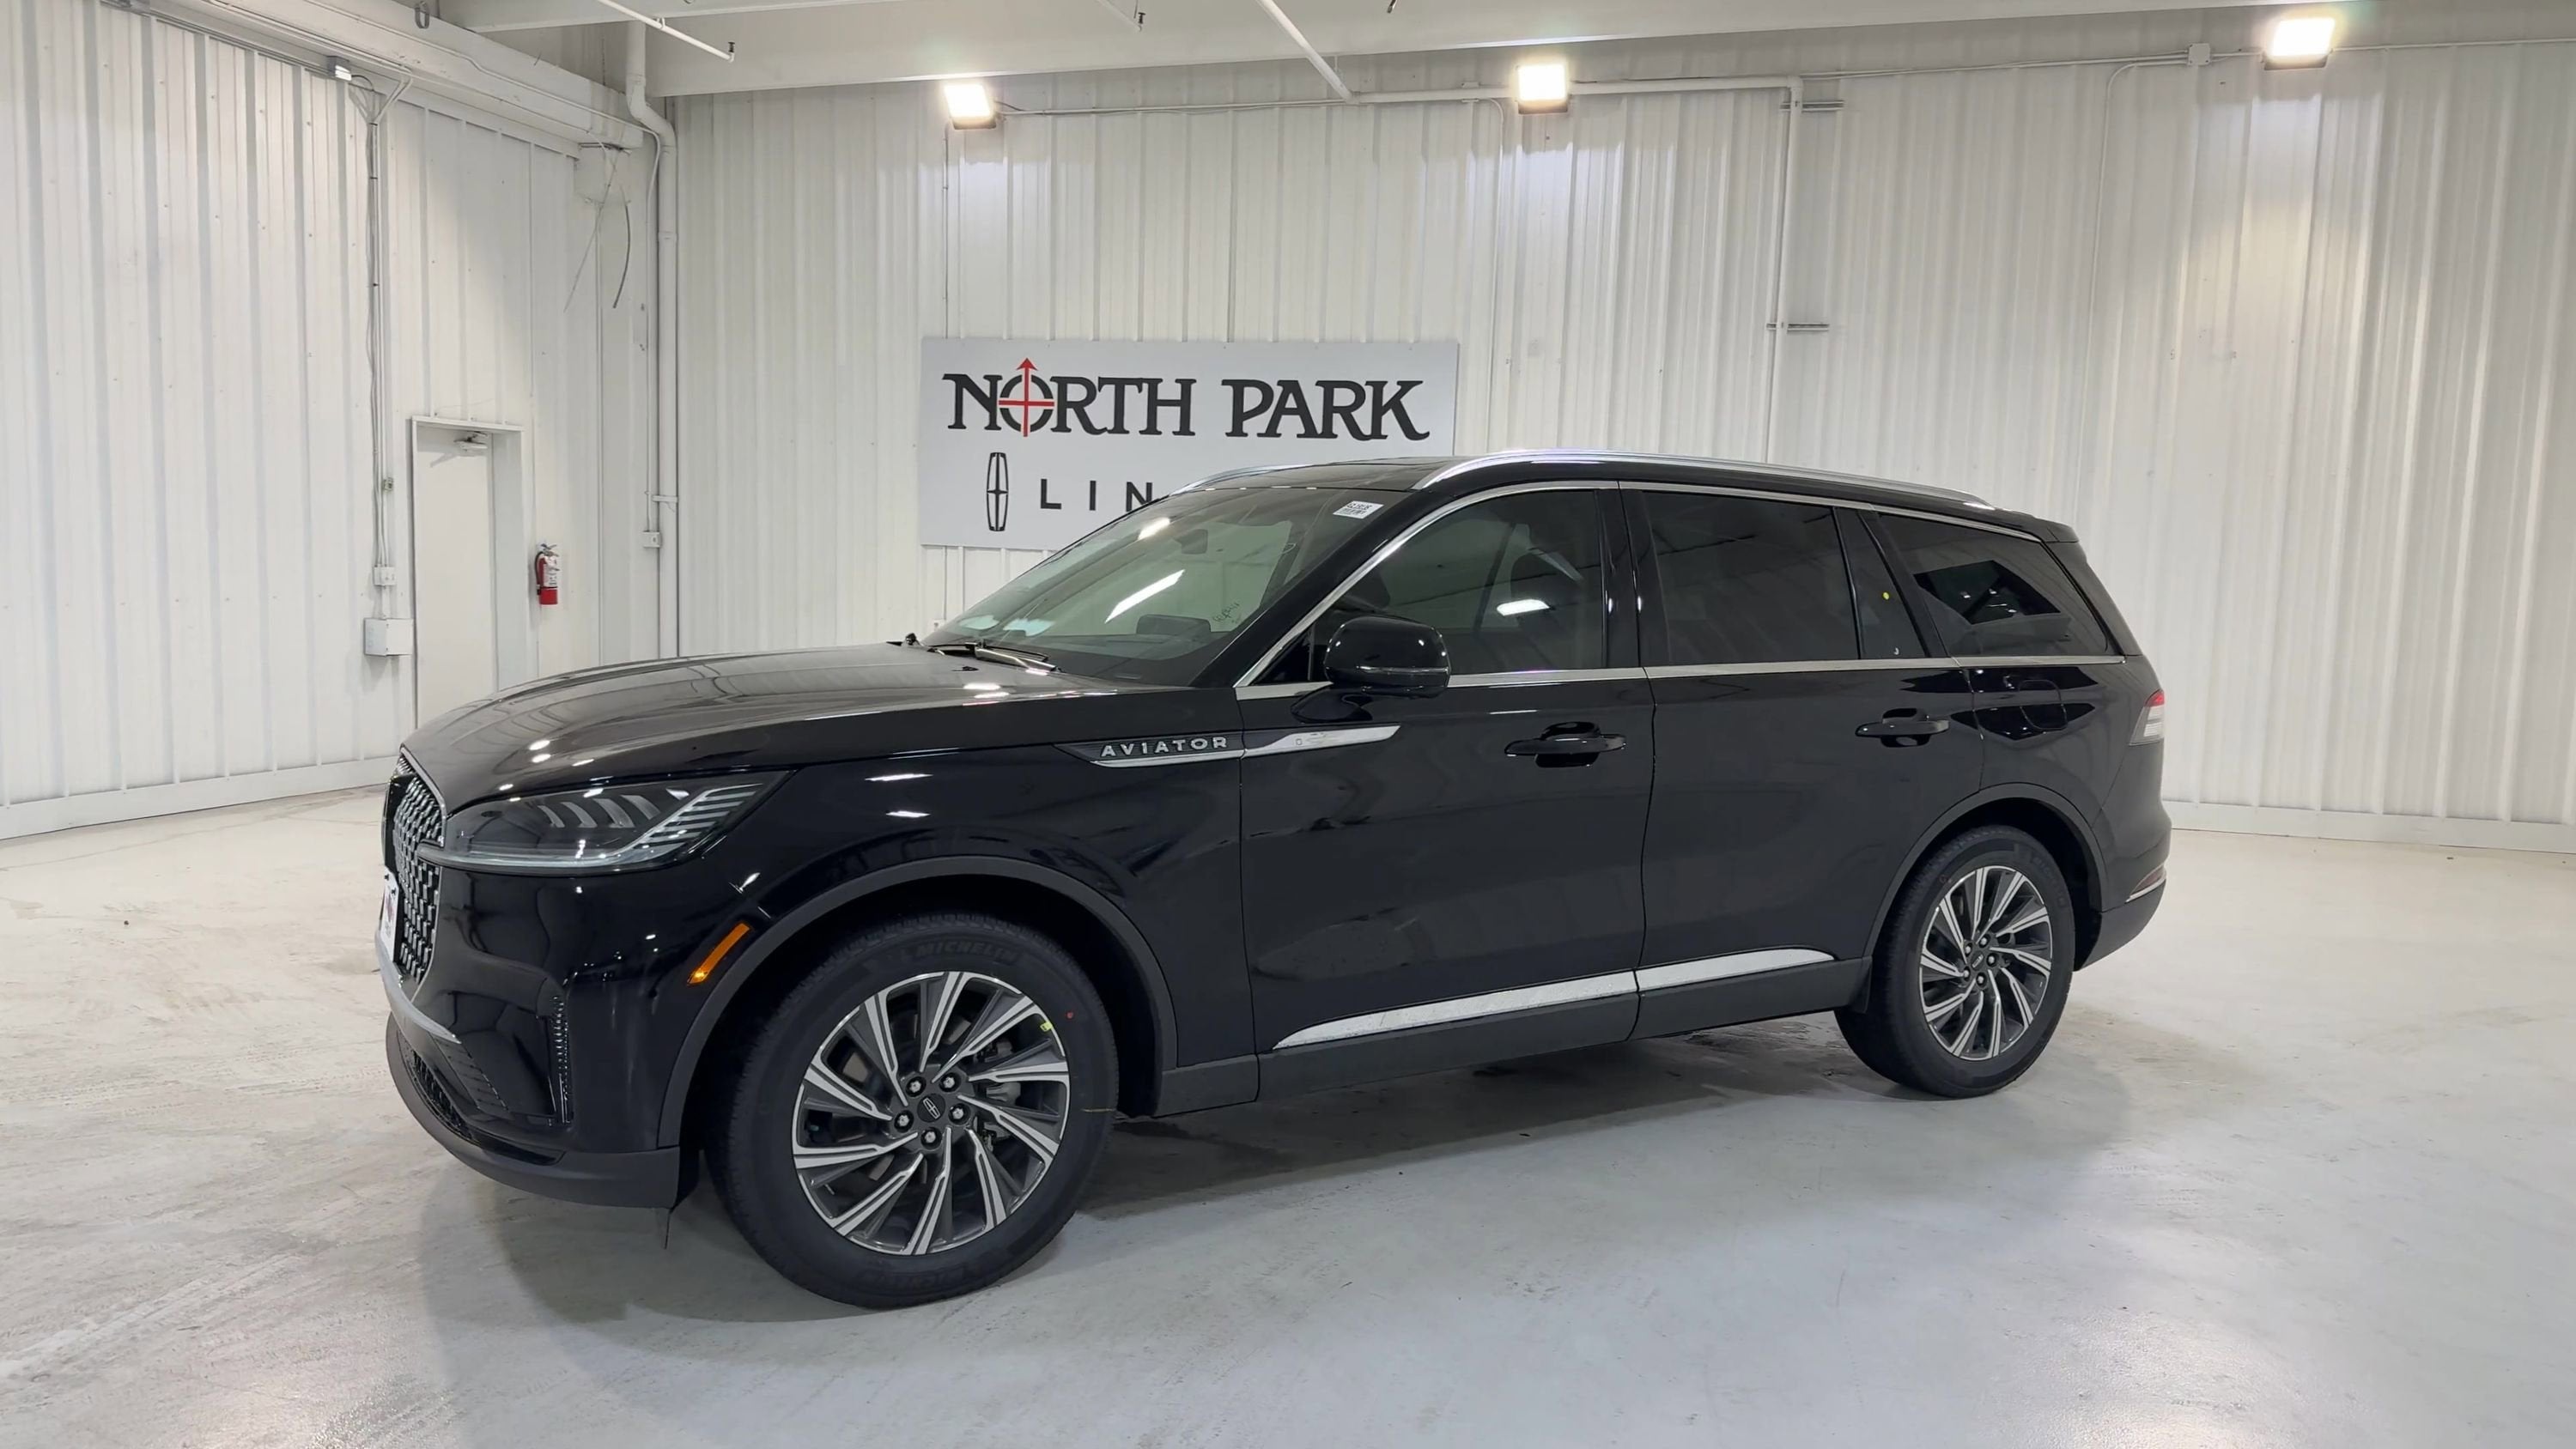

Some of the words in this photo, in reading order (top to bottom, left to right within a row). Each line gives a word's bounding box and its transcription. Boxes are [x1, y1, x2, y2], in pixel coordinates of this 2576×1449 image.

[942, 372, 1197, 437] NORTH
[1221, 379, 1431, 441] PARK
[1100, 736, 1228, 757] AVIATOR
